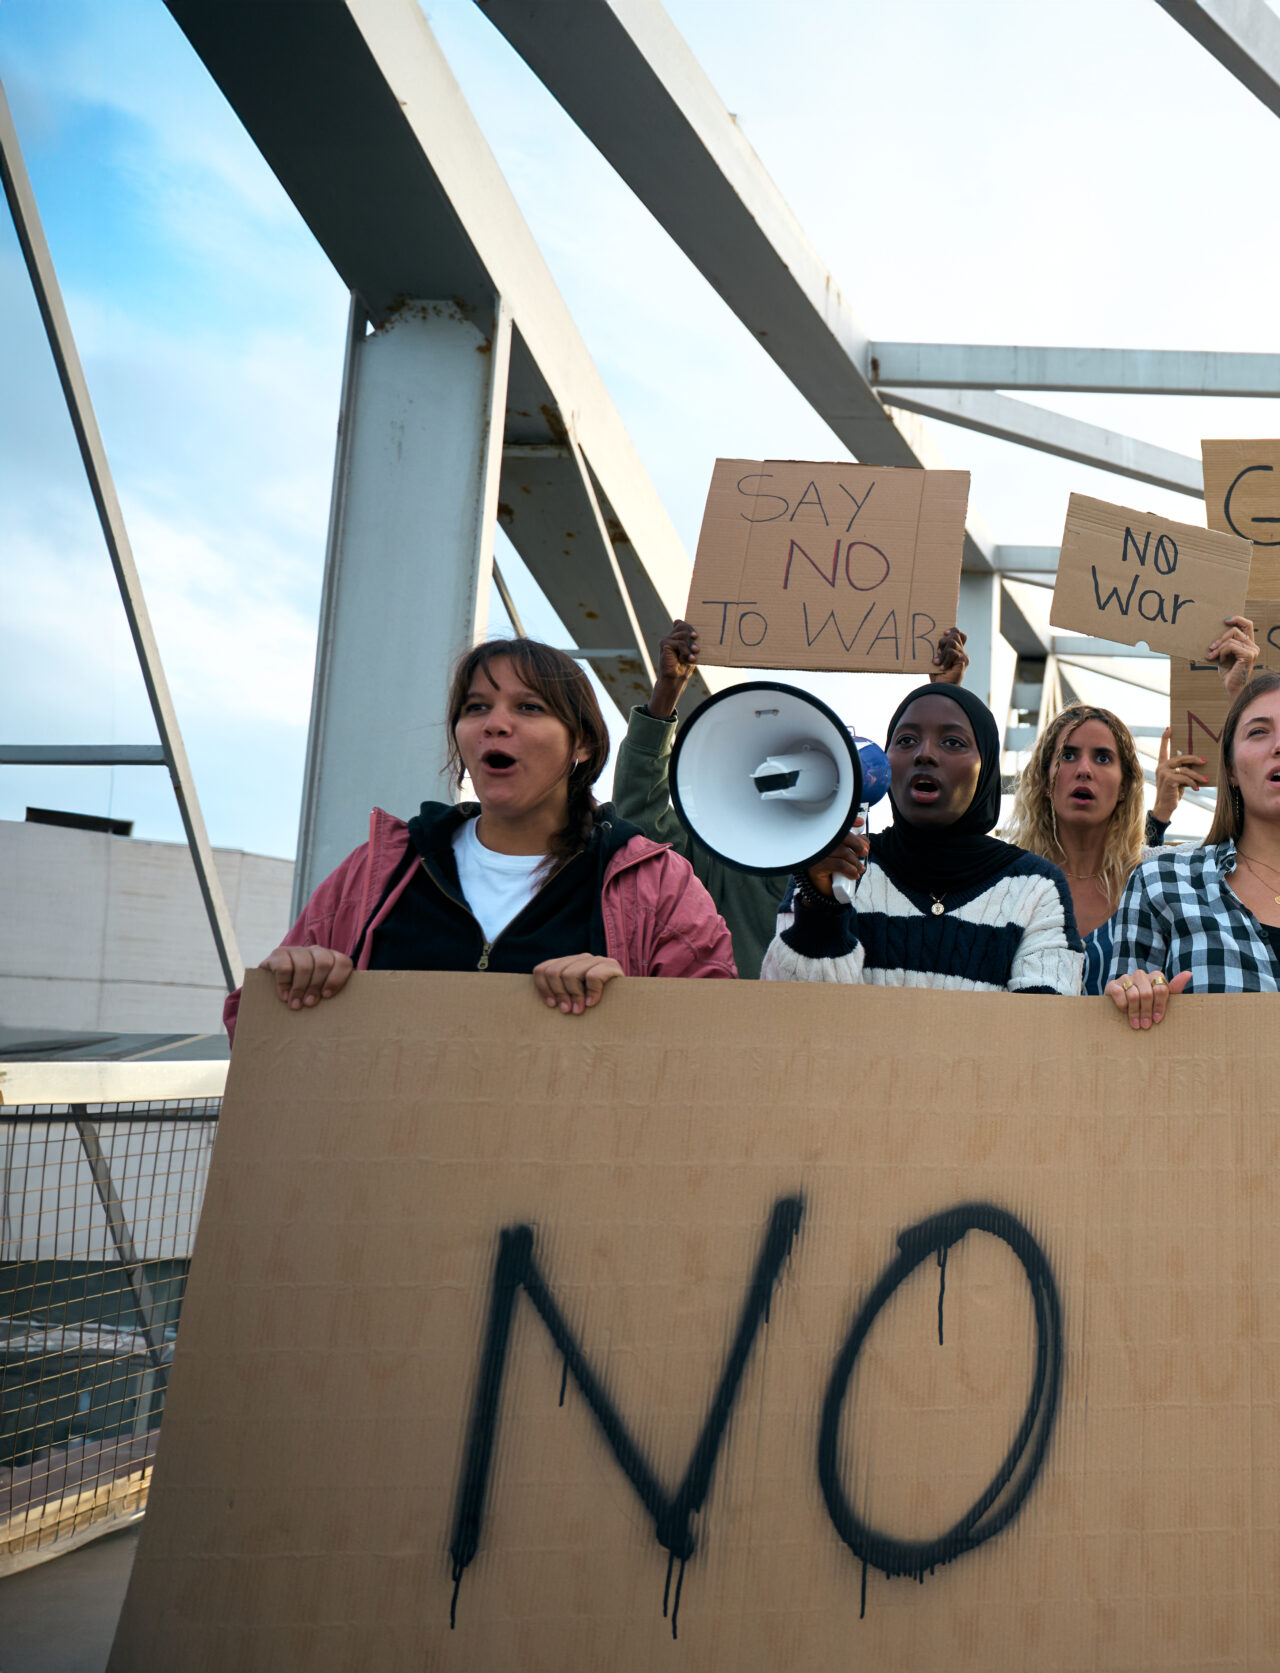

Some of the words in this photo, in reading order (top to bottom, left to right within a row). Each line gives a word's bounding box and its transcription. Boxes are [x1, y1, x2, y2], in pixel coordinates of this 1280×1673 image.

[737, 474, 875, 533] SAY
[782, 538, 890, 592] NO
[1091, 565, 1195, 624] War
[702, 601, 768, 647] TO
[803, 601, 937, 660] WAR
[447, 1195, 1065, 1595] NO
